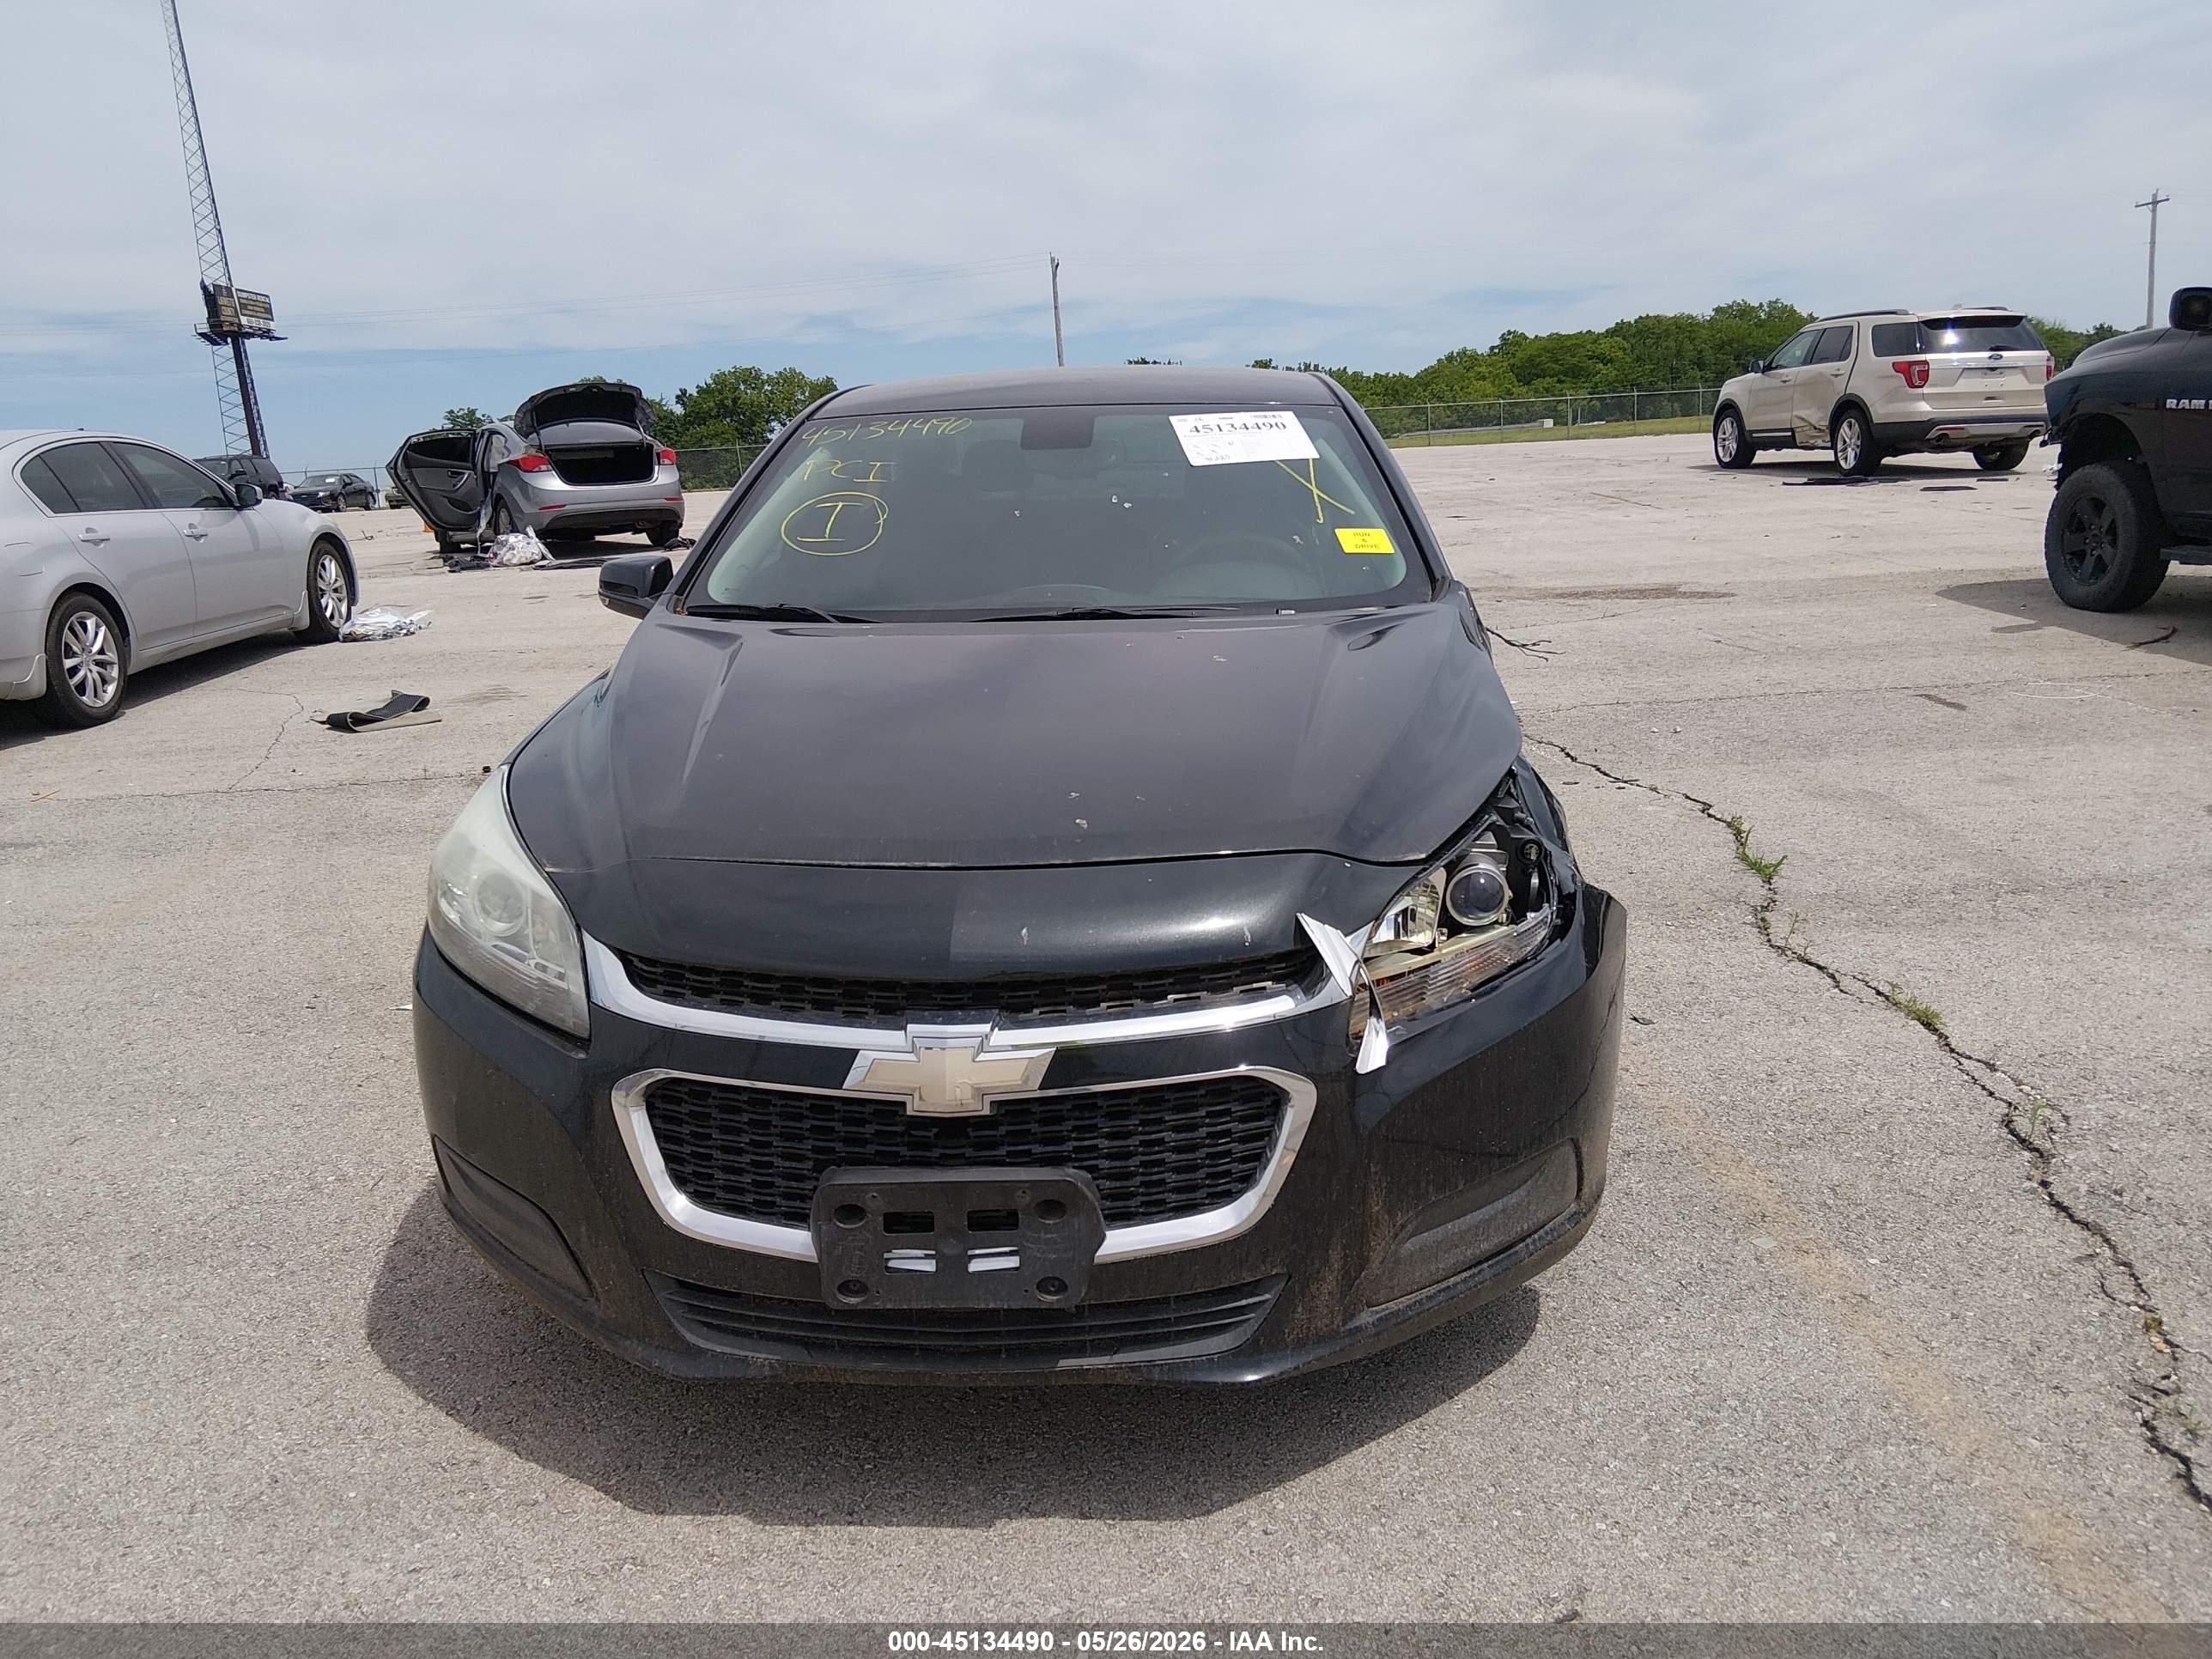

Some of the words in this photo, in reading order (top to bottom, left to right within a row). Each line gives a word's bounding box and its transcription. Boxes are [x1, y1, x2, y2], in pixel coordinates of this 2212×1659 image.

[2166, 398, 2206, 410] RAM
[801, 417, 973, 447] 45134490
[1189, 421, 1287, 434] 45134490
